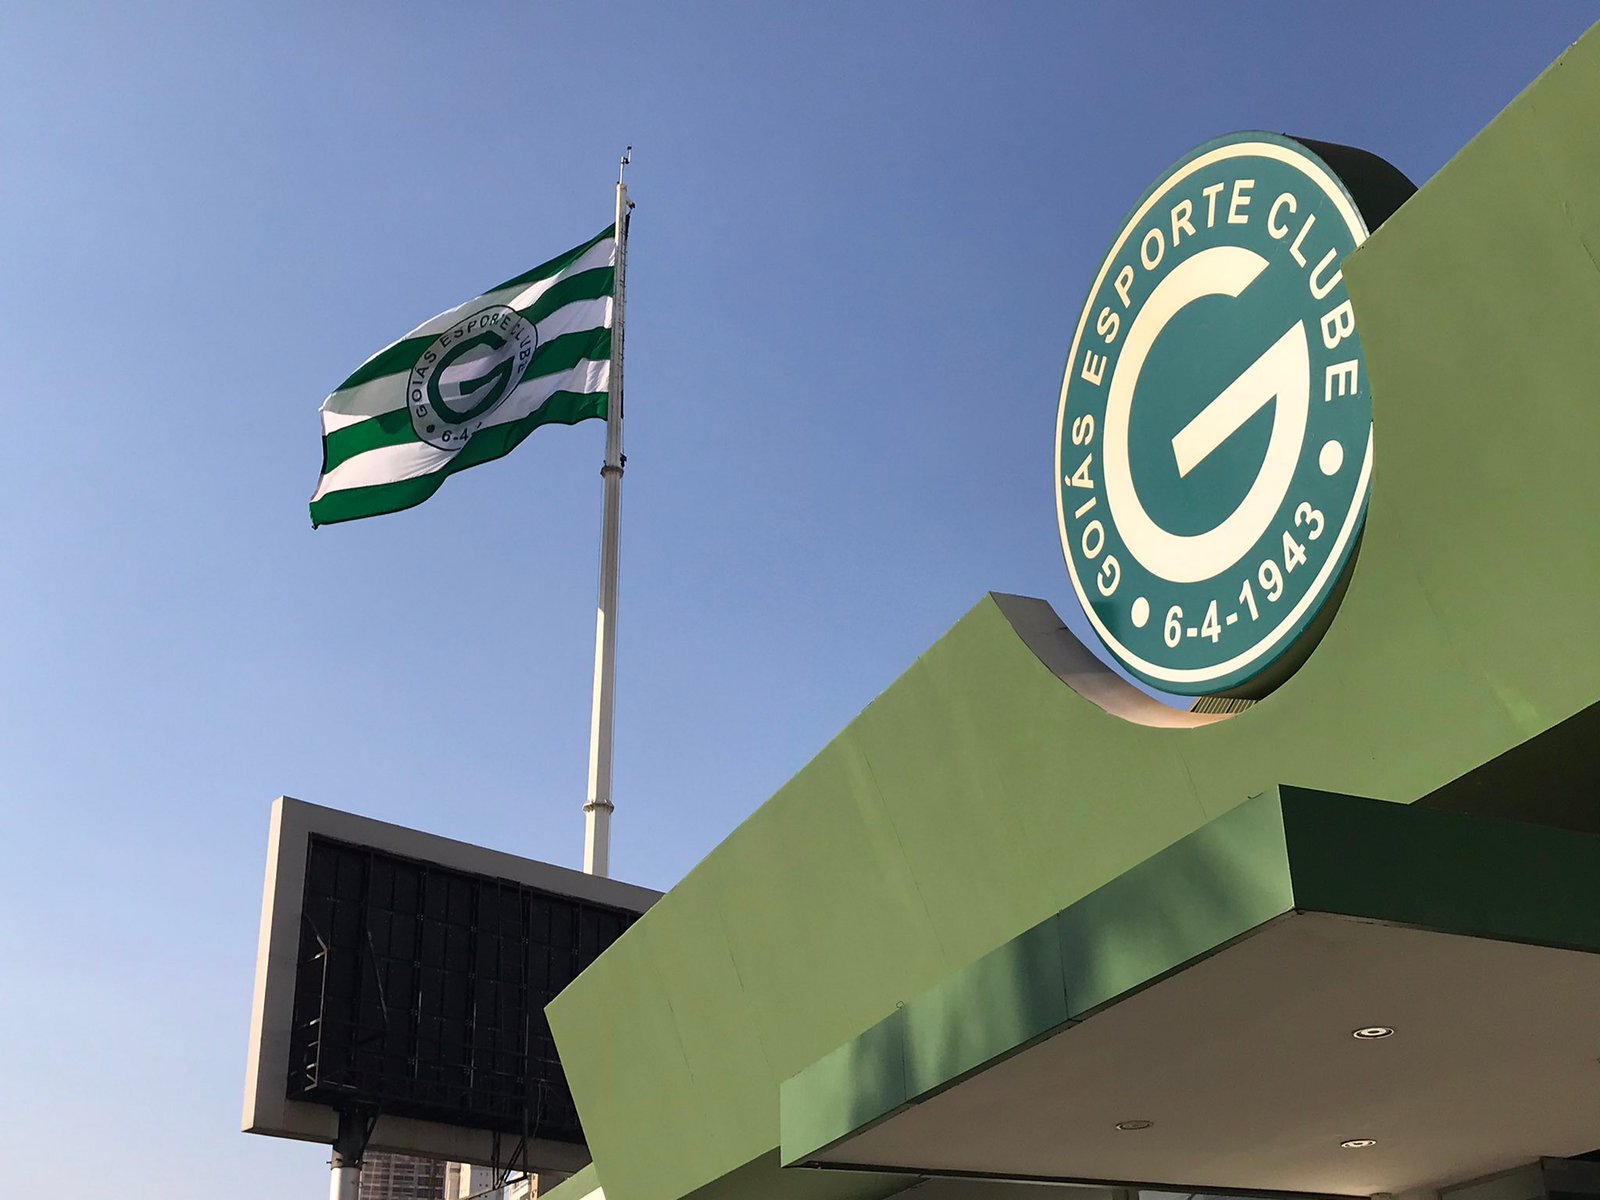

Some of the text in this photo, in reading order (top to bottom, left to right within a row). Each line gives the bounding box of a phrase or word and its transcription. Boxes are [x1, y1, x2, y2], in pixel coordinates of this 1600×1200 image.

[439, 312, 511, 348] ESPORE
[1064, 179, 1359, 597] GOIÁS ESPORTE CLUBE
[1164, 501, 1325, 648] 6-4-1943
